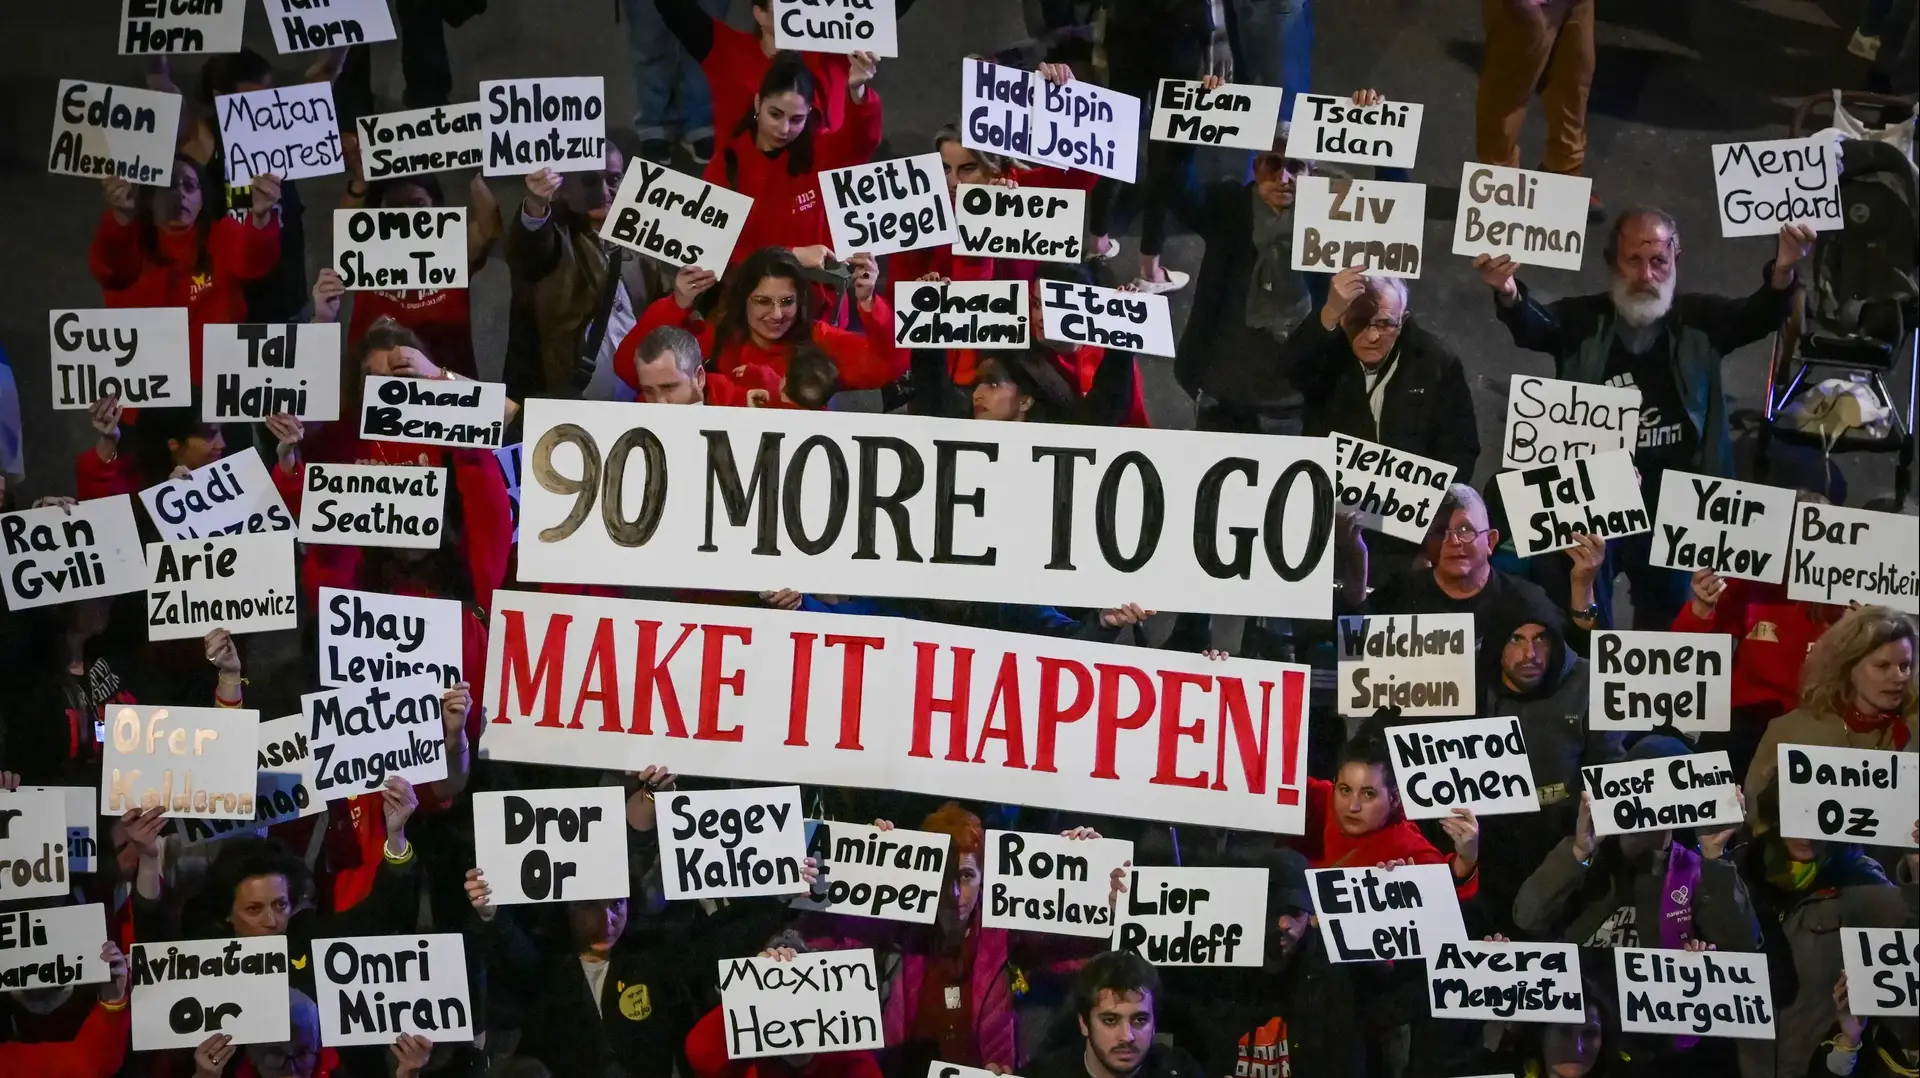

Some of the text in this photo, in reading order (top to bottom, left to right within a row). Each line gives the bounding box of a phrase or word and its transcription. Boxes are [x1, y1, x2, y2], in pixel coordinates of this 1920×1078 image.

[125, 21, 203, 53] Horn
[281, 17, 364, 50] Horn
[781, 8, 874, 40] Cunio
[61, 83, 155, 133] Edan
[224, 89, 334, 132] Matan
[489, 85, 601, 125] Shlomo
[1045, 79, 1113, 127] Bipin
[1160, 81, 1252, 113] Eitan
[1307, 96, 1409, 128] Tsachi
[359, 108, 481, 146] Yonatan
[490, 127, 606, 168] Mantzur
[1038, 121, 1115, 170] Joshi
[1167, 113, 1239, 144] Mor
[1316, 126, 1393, 158] Idan
[50, 130, 163, 183] Alexander
[229, 134, 344, 182] Angrest
[1718, 143, 1827, 191] Meny
[633, 162, 728, 230] Yarden
[831, 158, 930, 210] Keith
[963, 188, 1068, 219] Omer
[1328, 178, 1396, 224] Ziv
[1469, 169, 1538, 209] Gali
[1724, 187, 1842, 224] Godard
[613, 207, 704, 265] Bibas
[844, 194, 947, 247] Siegel
[1465, 208, 1580, 254] Berman
[339, 250, 456, 287] Shem Tov
[1302, 227, 1419, 274] Berman
[911, 284, 1019, 315] Ohad
[1045, 282, 1147, 324] Itay
[54, 312, 138, 367] Guy
[237, 324, 298, 369] Tal
[896, 309, 1027, 345] Yahalomi
[1060, 314, 1144, 349] Chen
[57, 364, 170, 406] Illouz
[216, 374, 307, 418] Haimi
[378, 381, 482, 408] Ohad
[1514, 379, 1640, 431] Sahar
[156, 463, 244, 524] Gadi
[308, 465, 439, 497] Bannawat
[532, 423, 1335, 582] 90 MORE TO GO
[1522, 459, 1596, 508] Tal
[1692, 479, 1765, 527] Yair
[1, 515, 94, 555] Ran
[312, 500, 440, 536] Seathao
[1528, 505, 1648, 552] Shoham
[1802, 506, 1870, 545] Bar
[154, 542, 238, 583] Arie
[1662, 524, 1772, 577] Yaakov
[12, 551, 106, 600] Gvili
[149, 587, 295, 626] Zalmanowicz
[329, 595, 425, 653] Shay
[1340, 615, 1464, 657] Watchara
[1598, 634, 1721, 676] Ronen
[310, 686, 441, 740] Matan
[490, 609, 1305, 807] MAKE IT HAPPEN!
[1603, 681, 1707, 727] Engel
[313, 730, 445, 791] Zangauker
[1394, 720, 1525, 769] Nimrod
[1406, 766, 1530, 808] Cohen
[1582, 766, 1654, 800] Yosef
[1788, 750, 1898, 789] Daniel
[503, 795, 602, 845] Dror
[671, 795, 791, 848] Segev
[1613, 796, 1716, 830] Ohana
[1817, 799, 1880, 837] Oz
[675, 847, 799, 892] Kalfon
[806, 823, 943, 873] Amiram
[999, 833, 1088, 882] Rom
[520, 849, 576, 900] Or
[1128, 871, 1210, 916] Lior
[1315, 869, 1423, 914] Eitan
[0, 912, 48, 949] Eli
[1119, 920, 1243, 964] Rudeff
[1329, 919, 1421, 961] Levi
[1858, 931, 1919, 967] Id
[131, 940, 287, 985] Avinatan
[324, 939, 430, 985] Omri
[721, 958, 877, 995] Maxim
[1435, 943, 1567, 973] Avera
[1624, 952, 1755, 998] Eliyhu
[339, 989, 466, 1035] Miran
[1432, 978, 1582, 1017] Mengistu
[1627, 991, 1772, 1033] Margalit
[729, 1005, 877, 1055] Herkin
